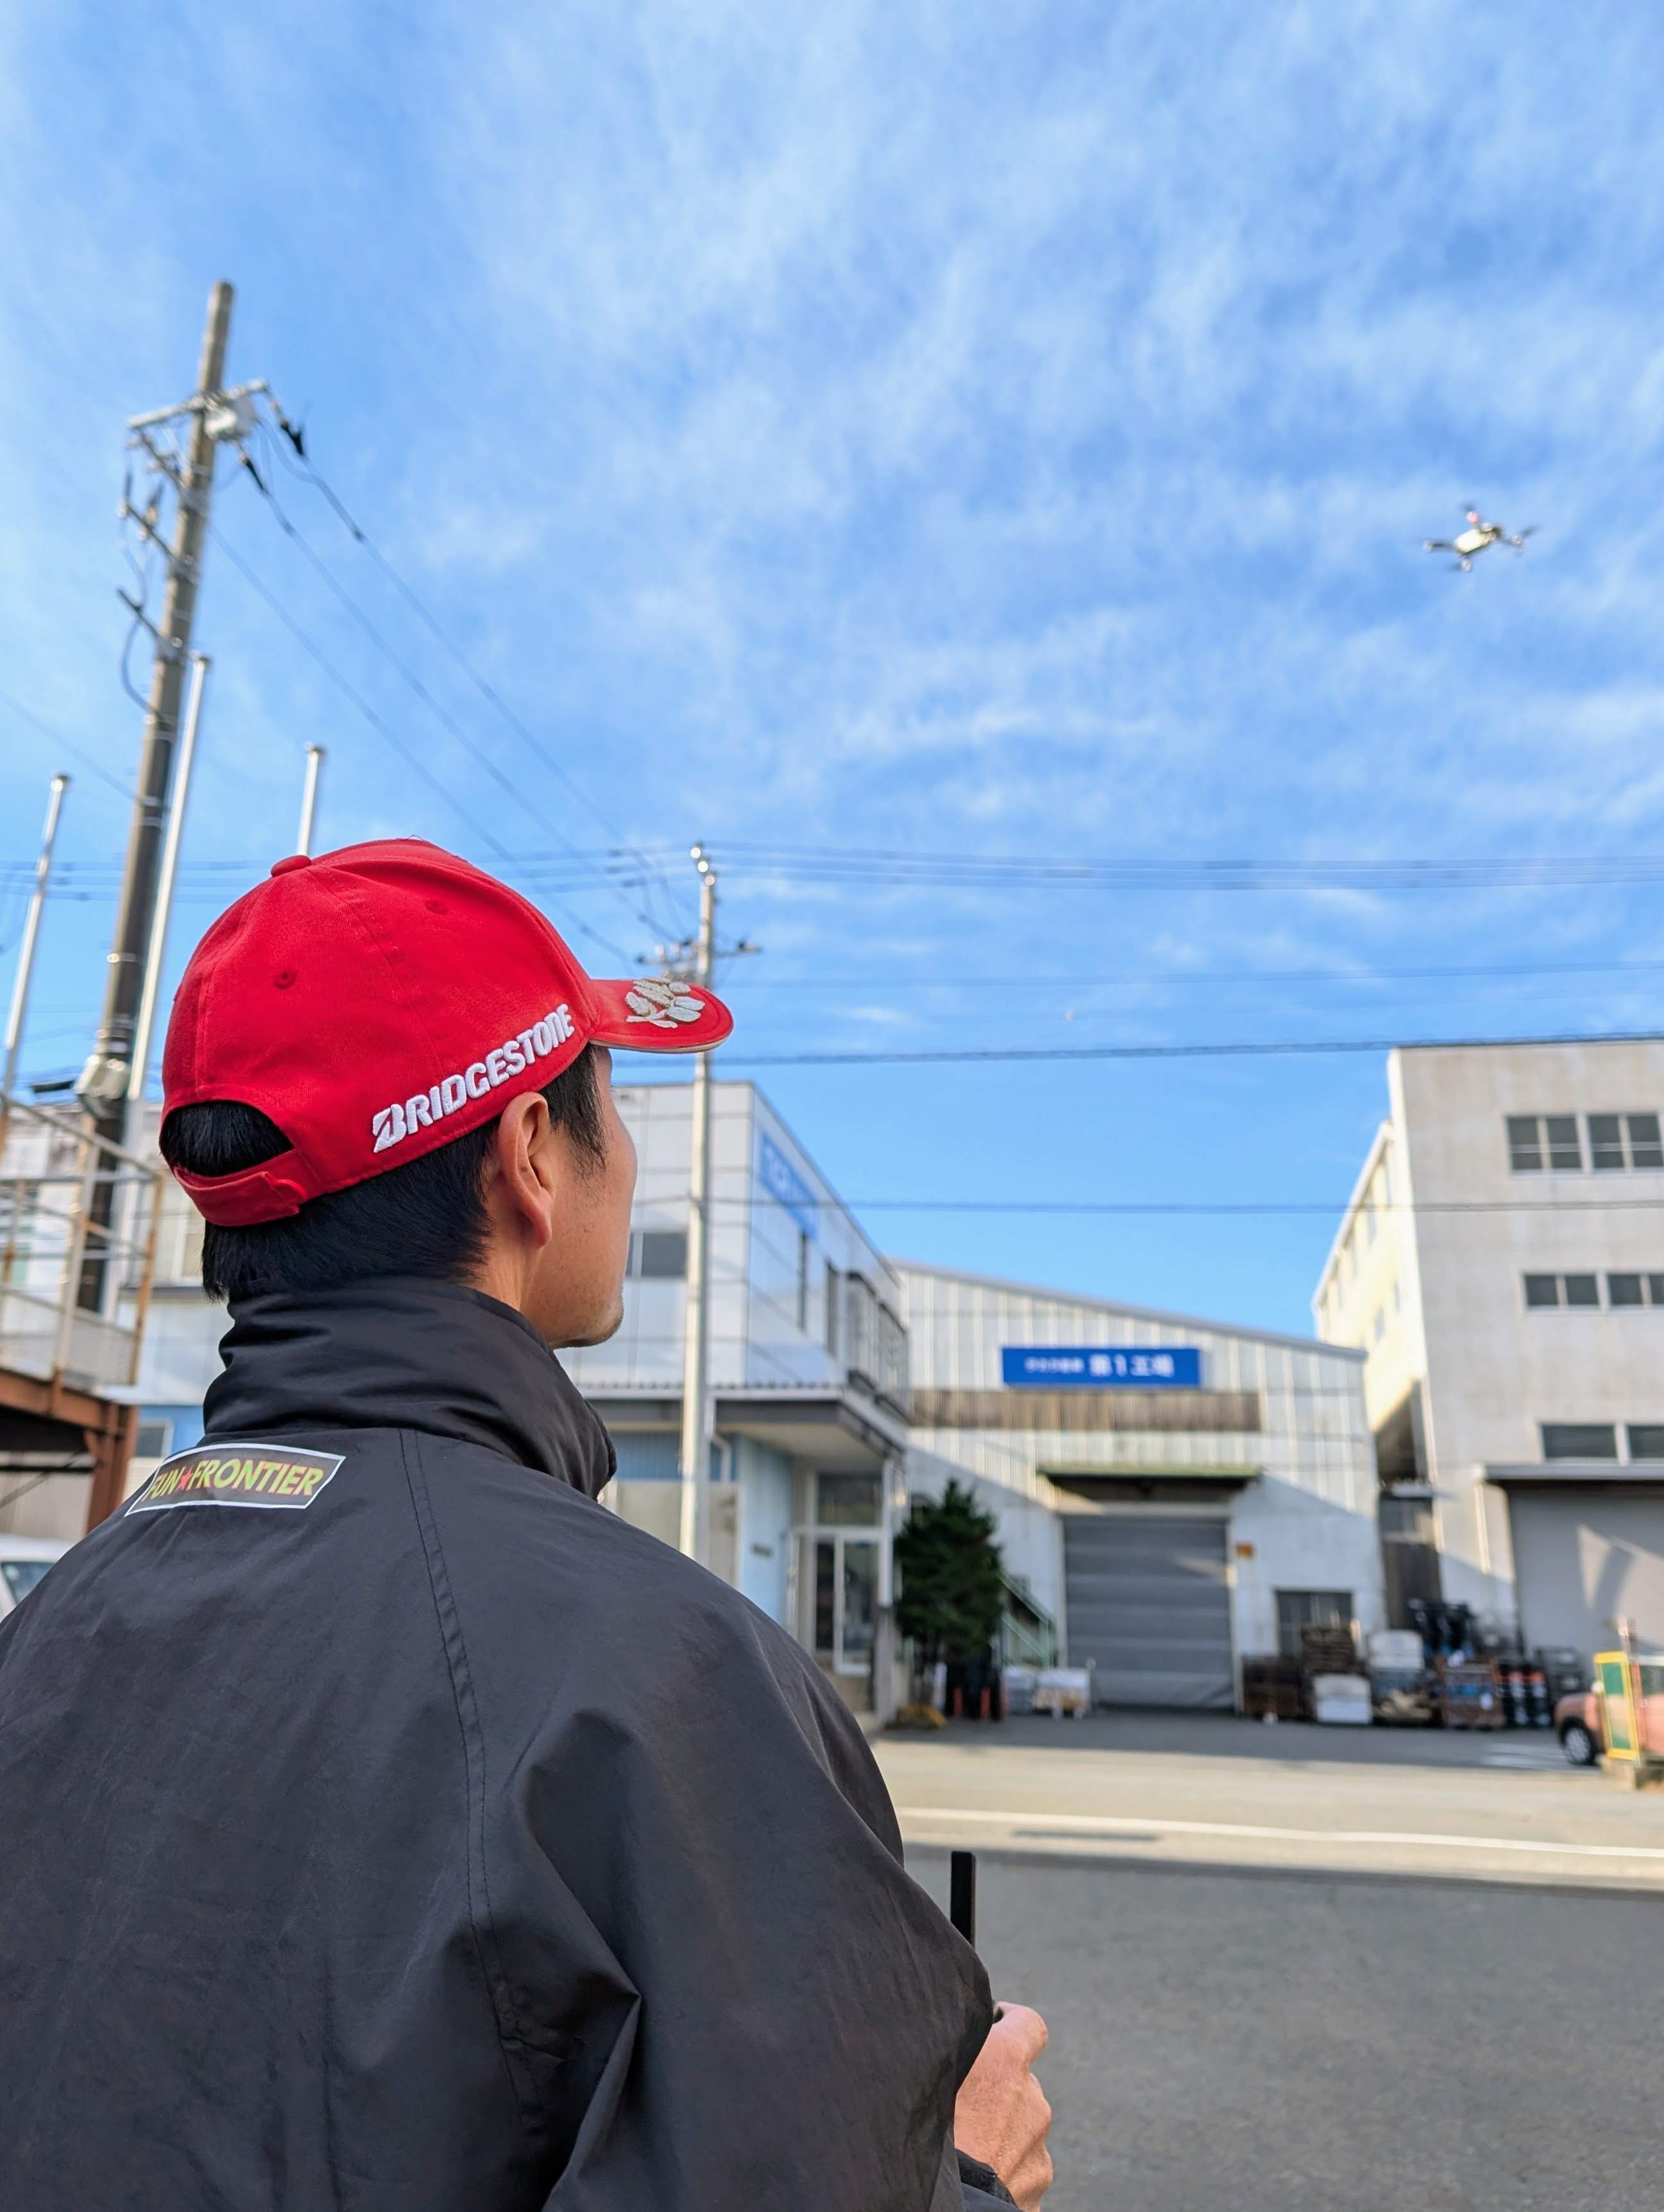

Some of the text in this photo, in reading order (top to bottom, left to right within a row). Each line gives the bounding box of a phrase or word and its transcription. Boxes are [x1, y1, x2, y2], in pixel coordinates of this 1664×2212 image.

[371, 1003, 575, 1153] BRIDGESTONE
[142, 1458, 325, 1502] FUN FRONTIER
